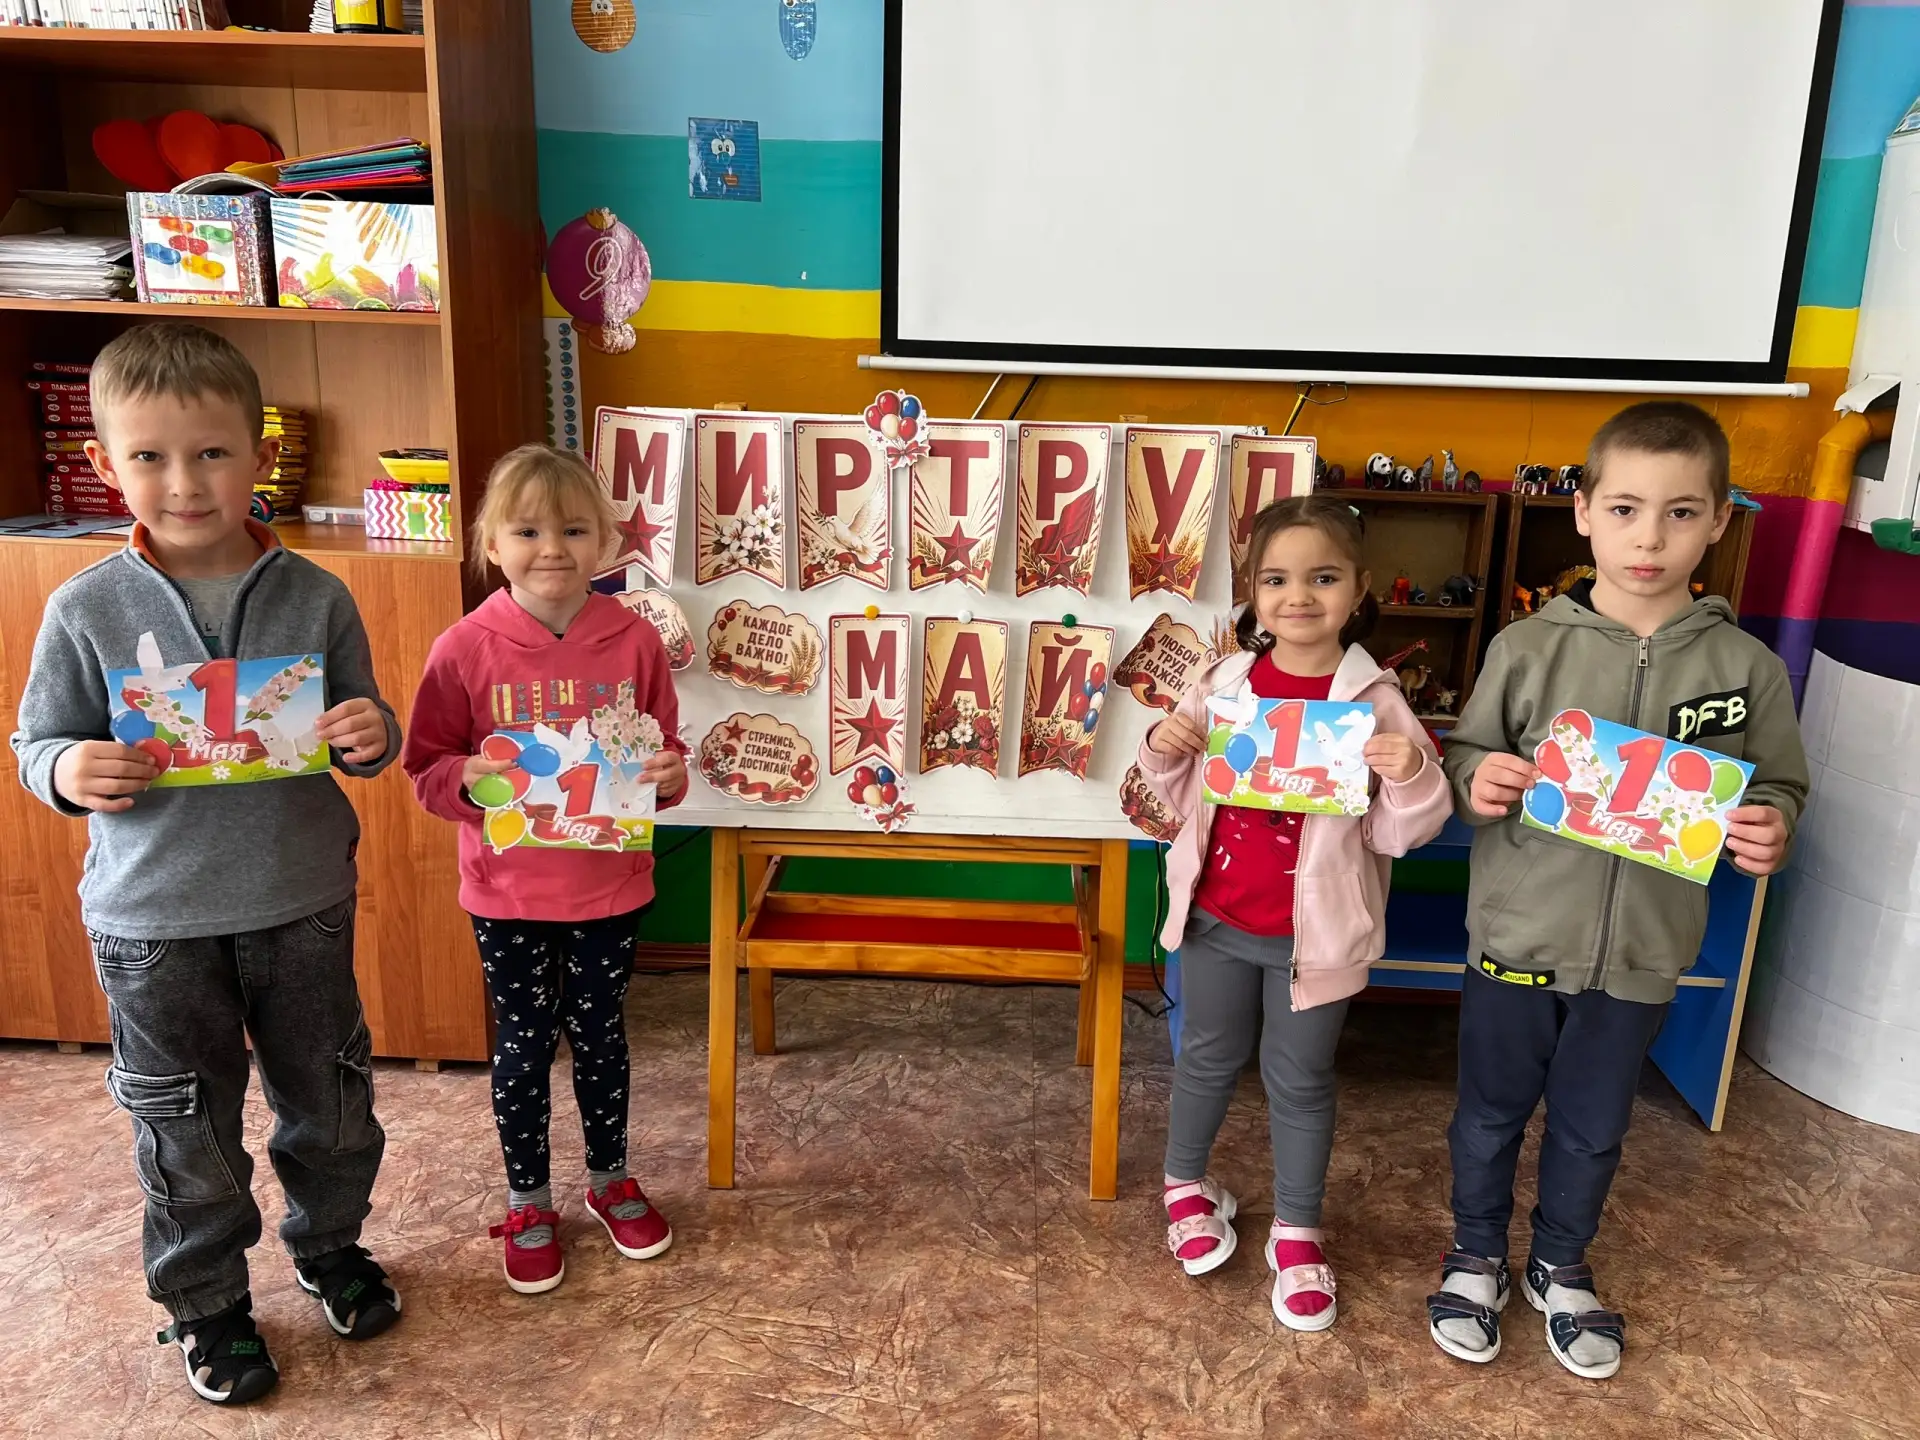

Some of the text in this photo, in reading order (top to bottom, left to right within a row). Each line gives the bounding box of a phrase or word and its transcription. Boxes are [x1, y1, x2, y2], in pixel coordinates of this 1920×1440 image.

[579, 237, 622, 300] 9
[612, 427, 872, 517] МИР
[651, 608, 668, 622] НАС
[743, 615, 794, 637] КАЖДОЕ
[735, 643, 789, 665] ВАЖНО!
[747, 632, 784, 649] ДЕЛО
[1158, 634, 1201, 667] ЛЮБОЙ
[846, 630, 1093, 720] МАЙ
[1143, 659, 1193, 696] ВАЖЕН!
[1157, 649, 1188, 677] ТРУД
[189, 658, 237, 740] 1
[1677, 696, 1747, 742] DFB
[748, 730, 796, 750] СТРЕМИСЬ,
[1264, 700, 1306, 769] 1
[188, 741, 248, 761] МАЯ
[738, 756, 790, 776] ДОСТИГАЙ!
[744, 743, 793, 763] СТАРАЙСЯ,
[556, 763, 600, 816] 1
[1268, 769, 1316, 796] МАЯ
[1606, 736, 1666, 813] 1
[551, 816, 602, 842] МАЯ
[1591, 812, 1645, 844] МАЯ
